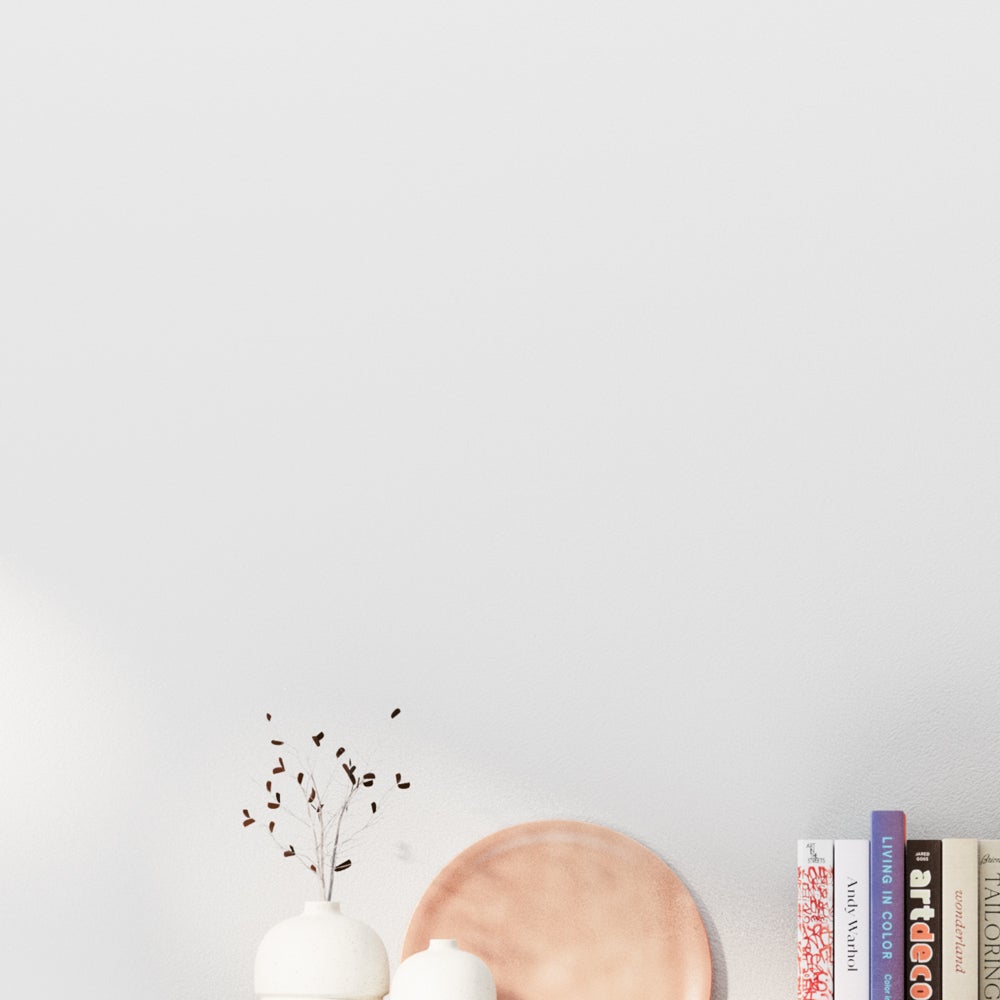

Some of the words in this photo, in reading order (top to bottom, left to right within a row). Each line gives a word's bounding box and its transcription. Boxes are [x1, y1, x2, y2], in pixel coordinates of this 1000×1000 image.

[882, 836, 893, 885] LIVING
[844, 876, 858, 917] Andy
[882, 890, 893, 905] IN
[847, 919, 858, 972] Warhol
[882, 911, 893, 960] COLOR
[954, 889, 966, 975] wonderland
[984, 872, 1000, 1000] TAILORING
[884, 974, 892, 994] Color
